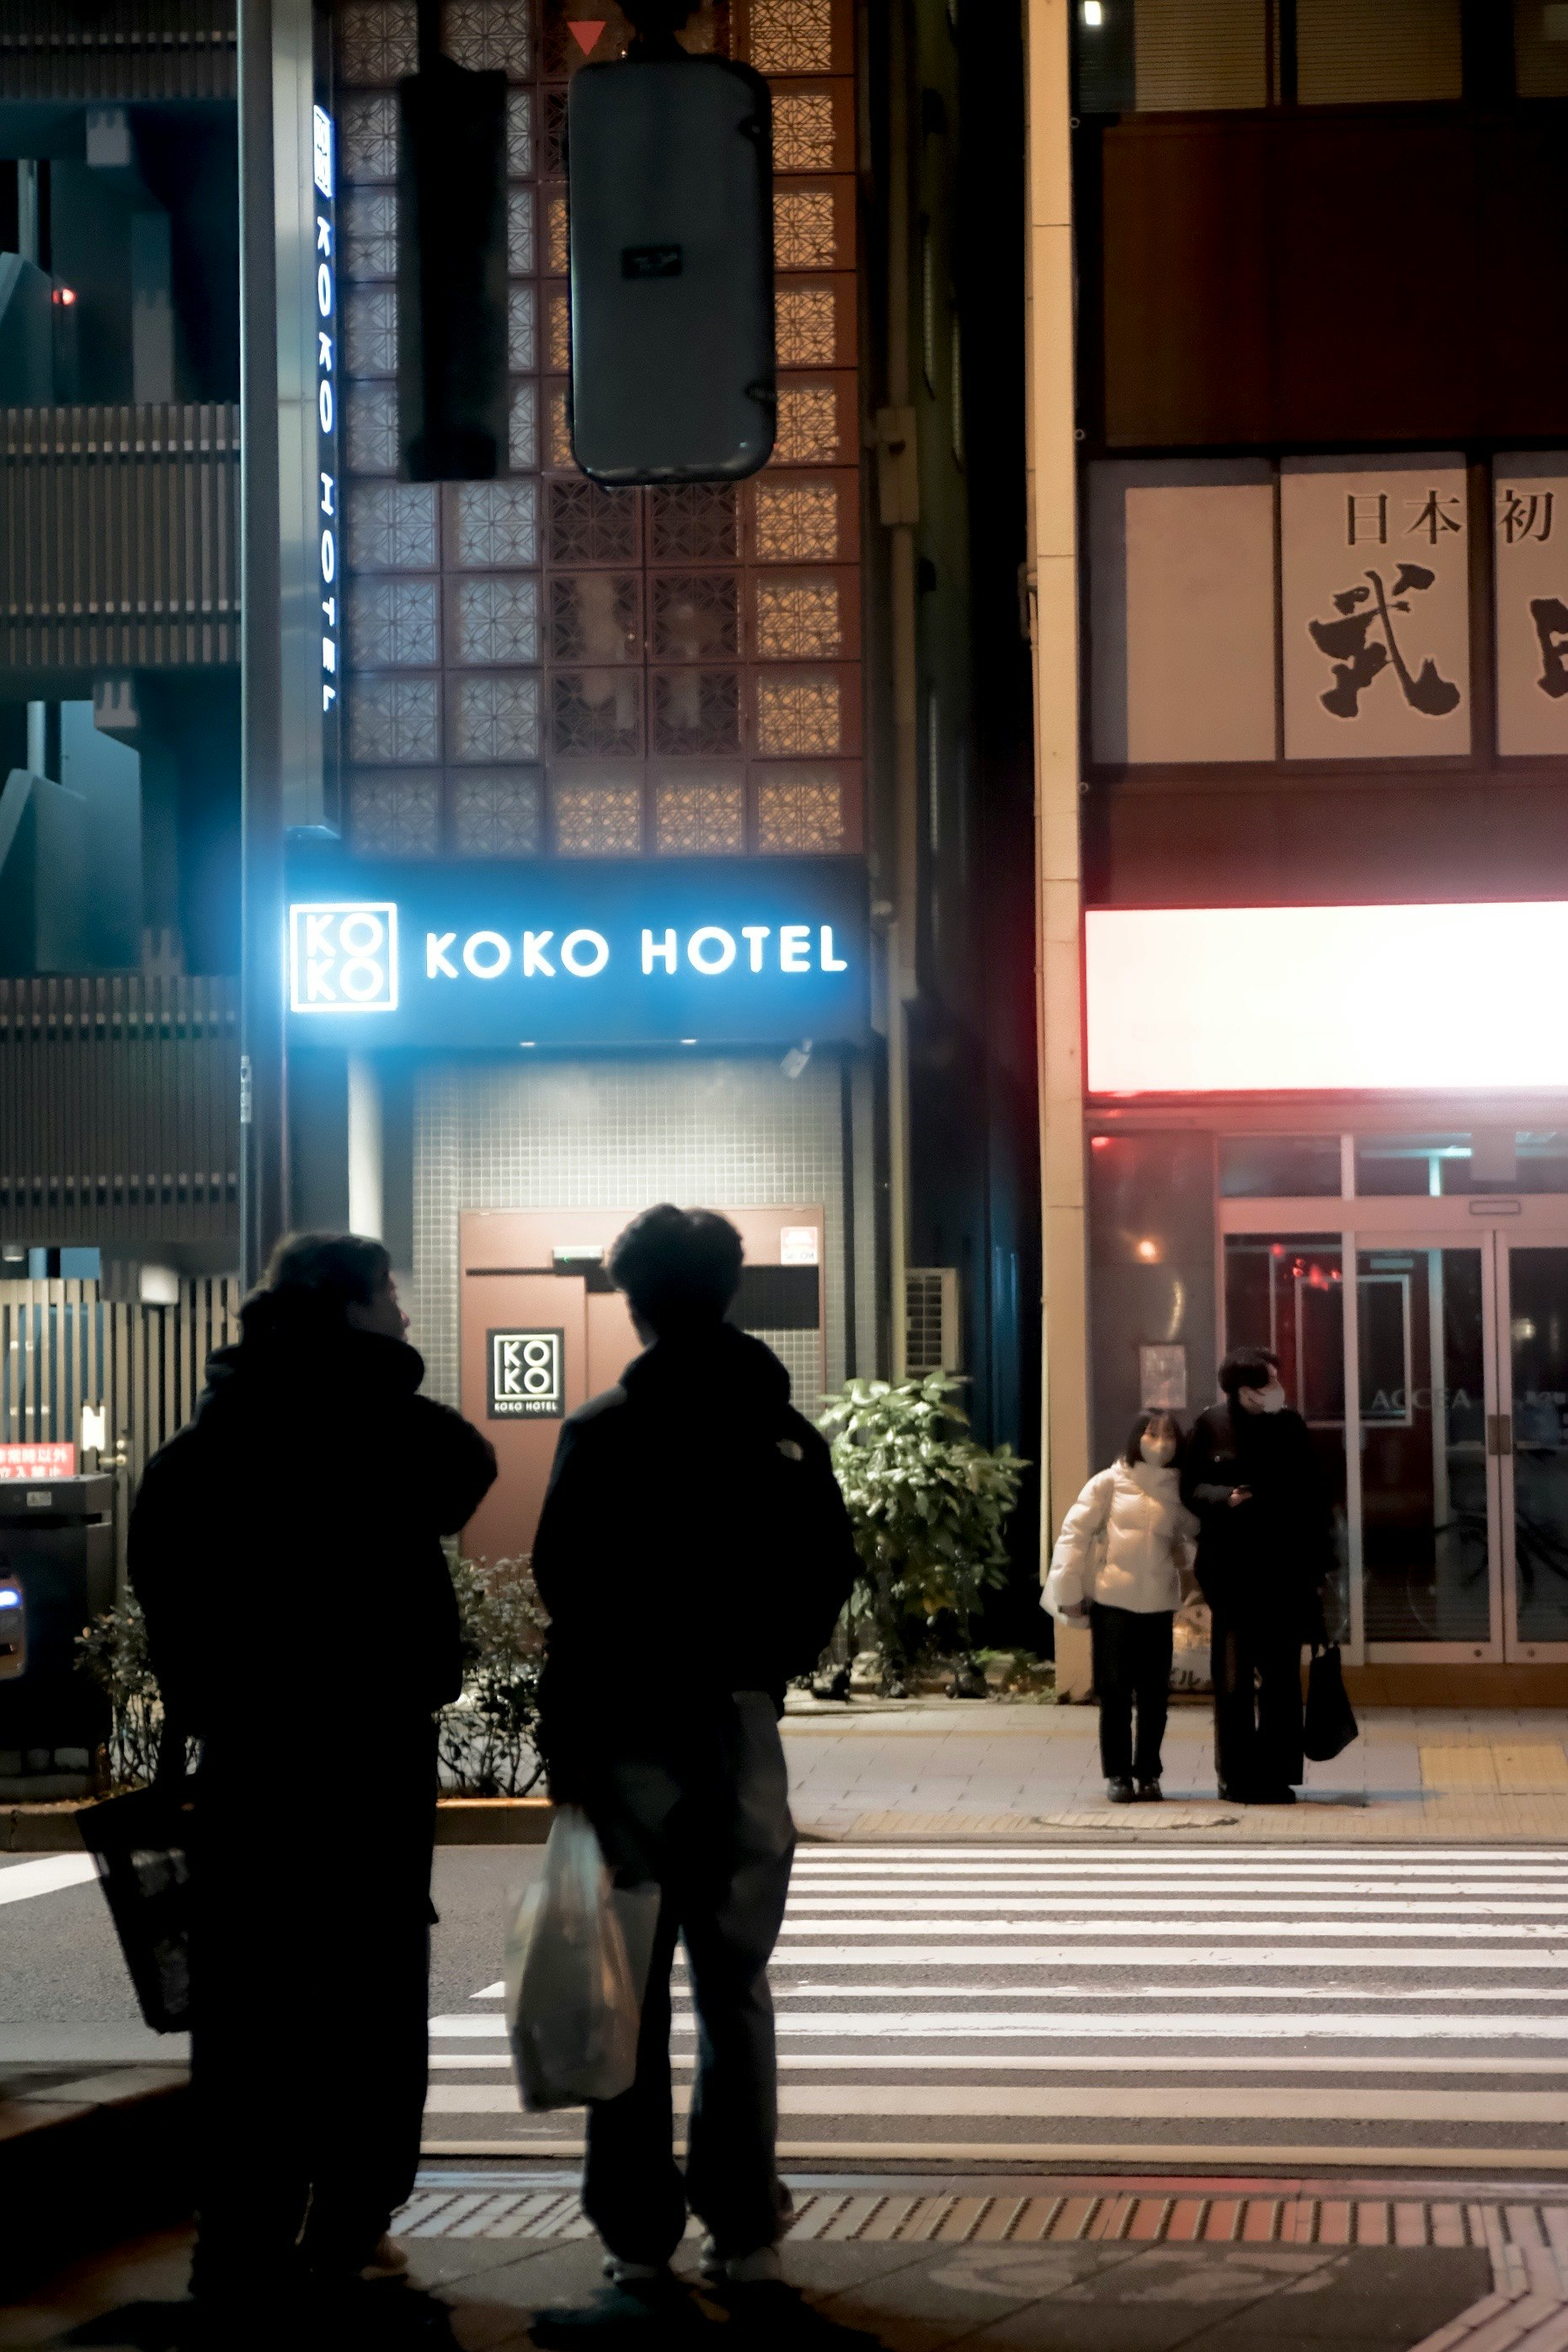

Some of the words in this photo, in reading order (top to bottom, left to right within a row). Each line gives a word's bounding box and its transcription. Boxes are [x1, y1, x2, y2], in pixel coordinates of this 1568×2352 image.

[317, 215, 333, 434] KOKO
[321, 472, 336, 712] HOTEL
[1309, 563, 1568, 717] 武
[425, 929, 609, 979] KOKO
[641, 925, 847, 975] HOTEL
[494, 1401, 522, 1413] KOKO
[525, 1401, 557, 1413] HOTEL
